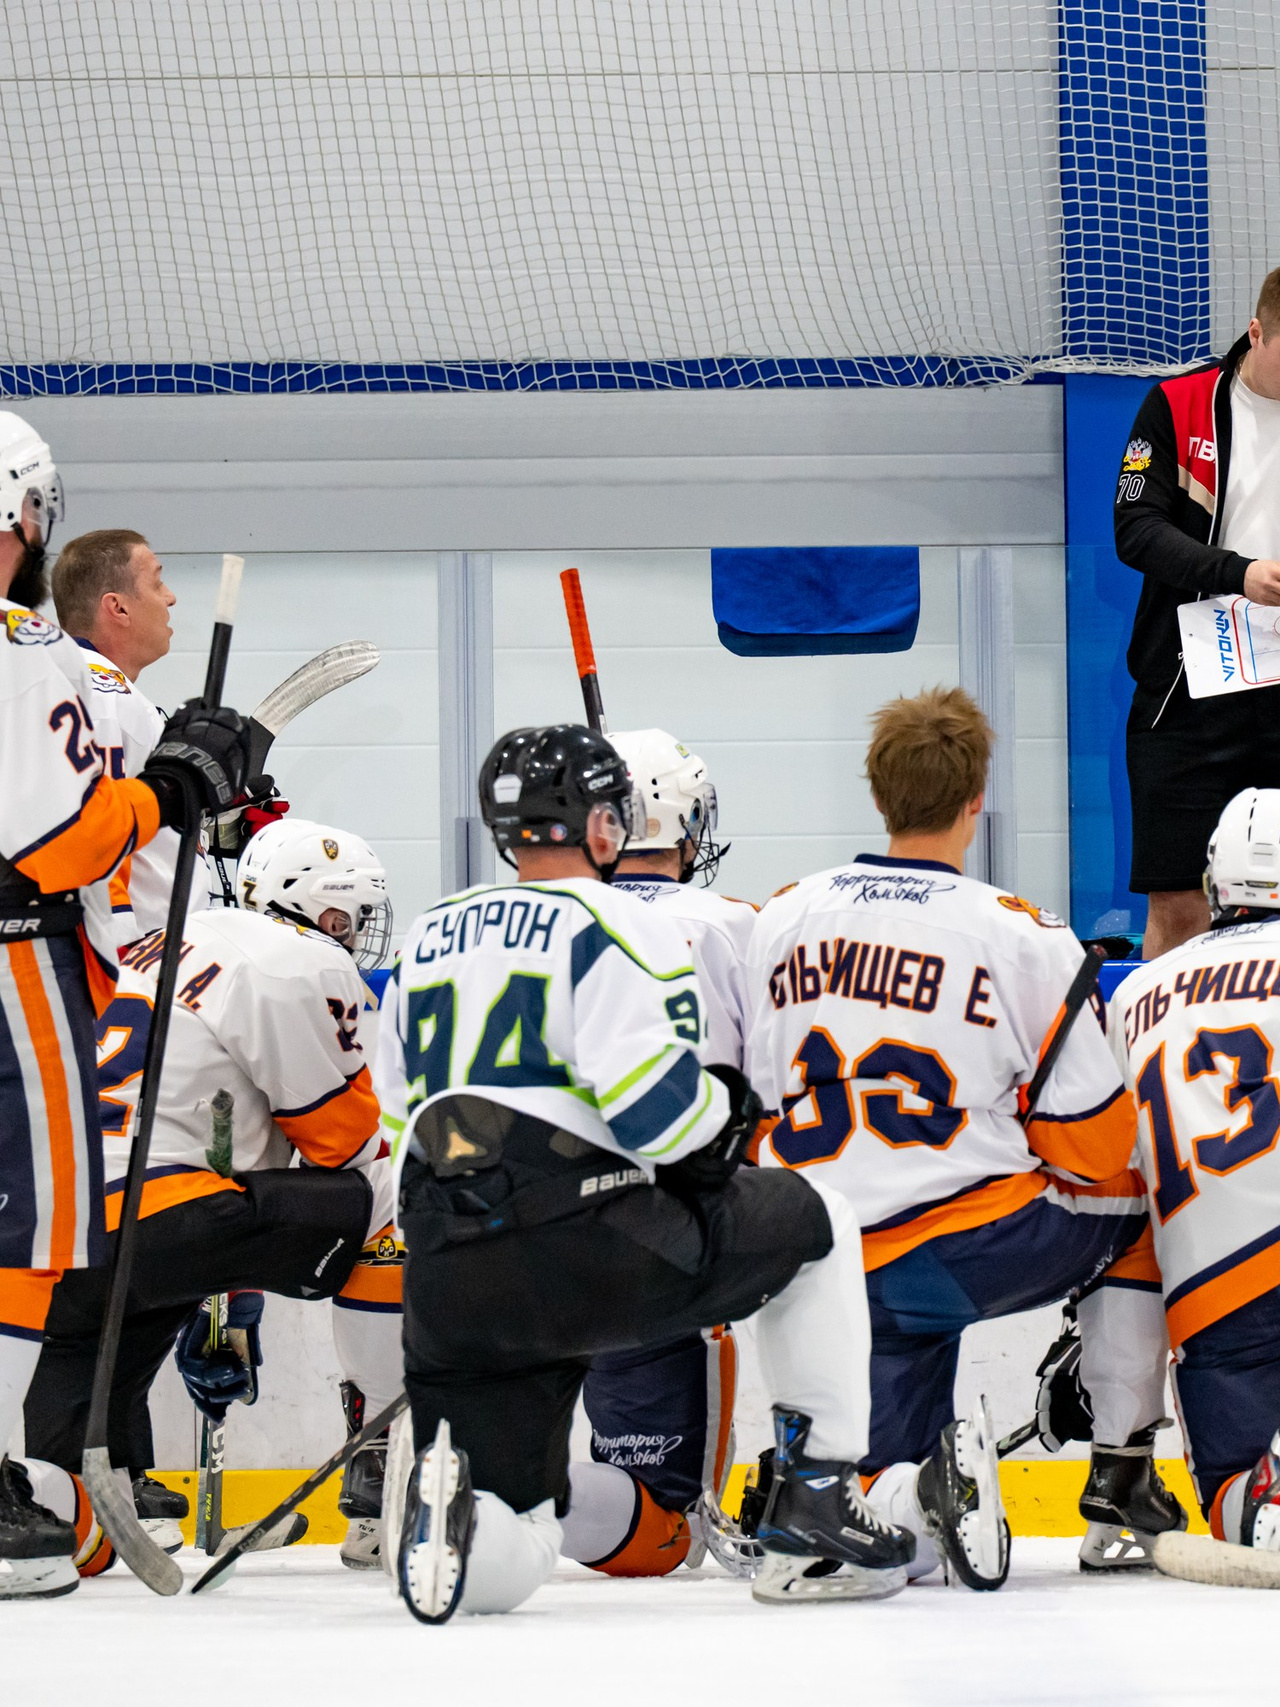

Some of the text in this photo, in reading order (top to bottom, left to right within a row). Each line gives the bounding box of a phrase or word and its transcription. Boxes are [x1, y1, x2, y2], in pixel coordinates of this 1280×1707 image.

[1189, 436, 1216, 464] ПВ
[20, 462, 40, 475] CCM
[1116, 473, 1145, 504] 70
[415, 900, 560, 964] СУПРОН
[405, 970, 576, 1113] 94
